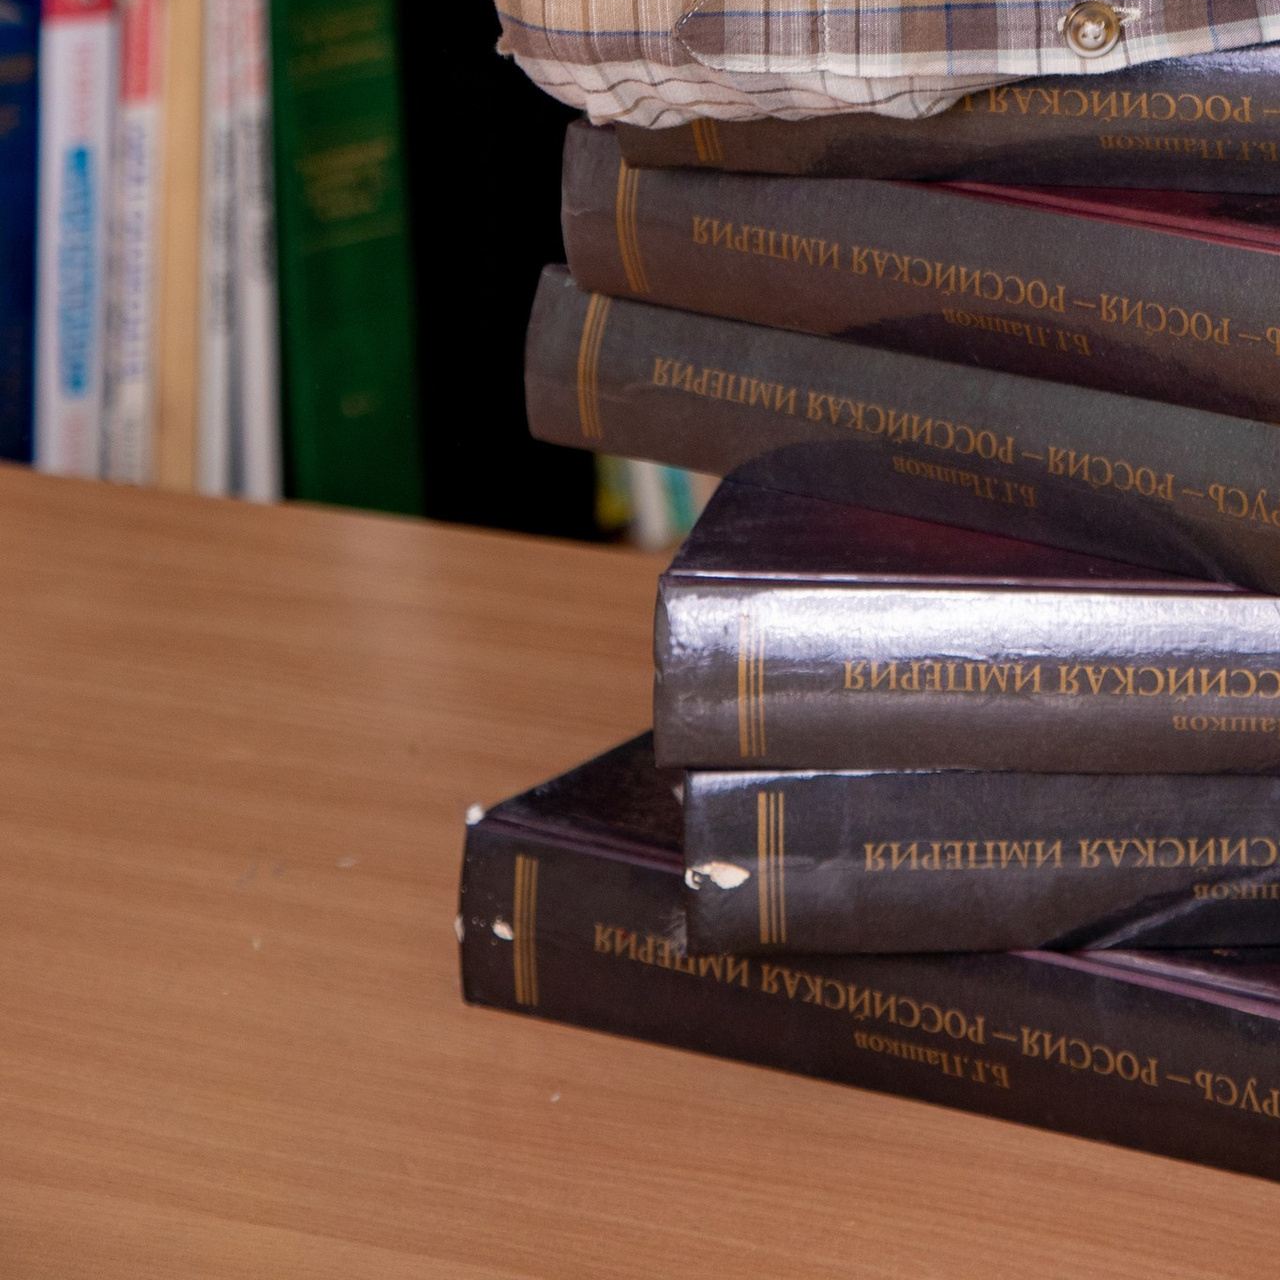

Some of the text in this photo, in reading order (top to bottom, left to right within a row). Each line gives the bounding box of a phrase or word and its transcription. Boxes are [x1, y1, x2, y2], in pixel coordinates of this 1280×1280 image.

[989, 87, 1253, 123] РОССИЙСКАЯ
[692, 214, 840, 270] ИМПЕРИЯ
[851, 245, 1066, 314] РОССИЙСКАЯ
[652, 356, 797, 414] ИМПЕРИЯ
[807, 390, 1015, 466] РОССИЙСКАЯ
[844, 660, 1041, 693] ИМПЕРИЯ
[863, 839, 1063, 871] ИМПЕРИЯ
[760, 963, 986, 1044] РОССИЙСКАЯ
